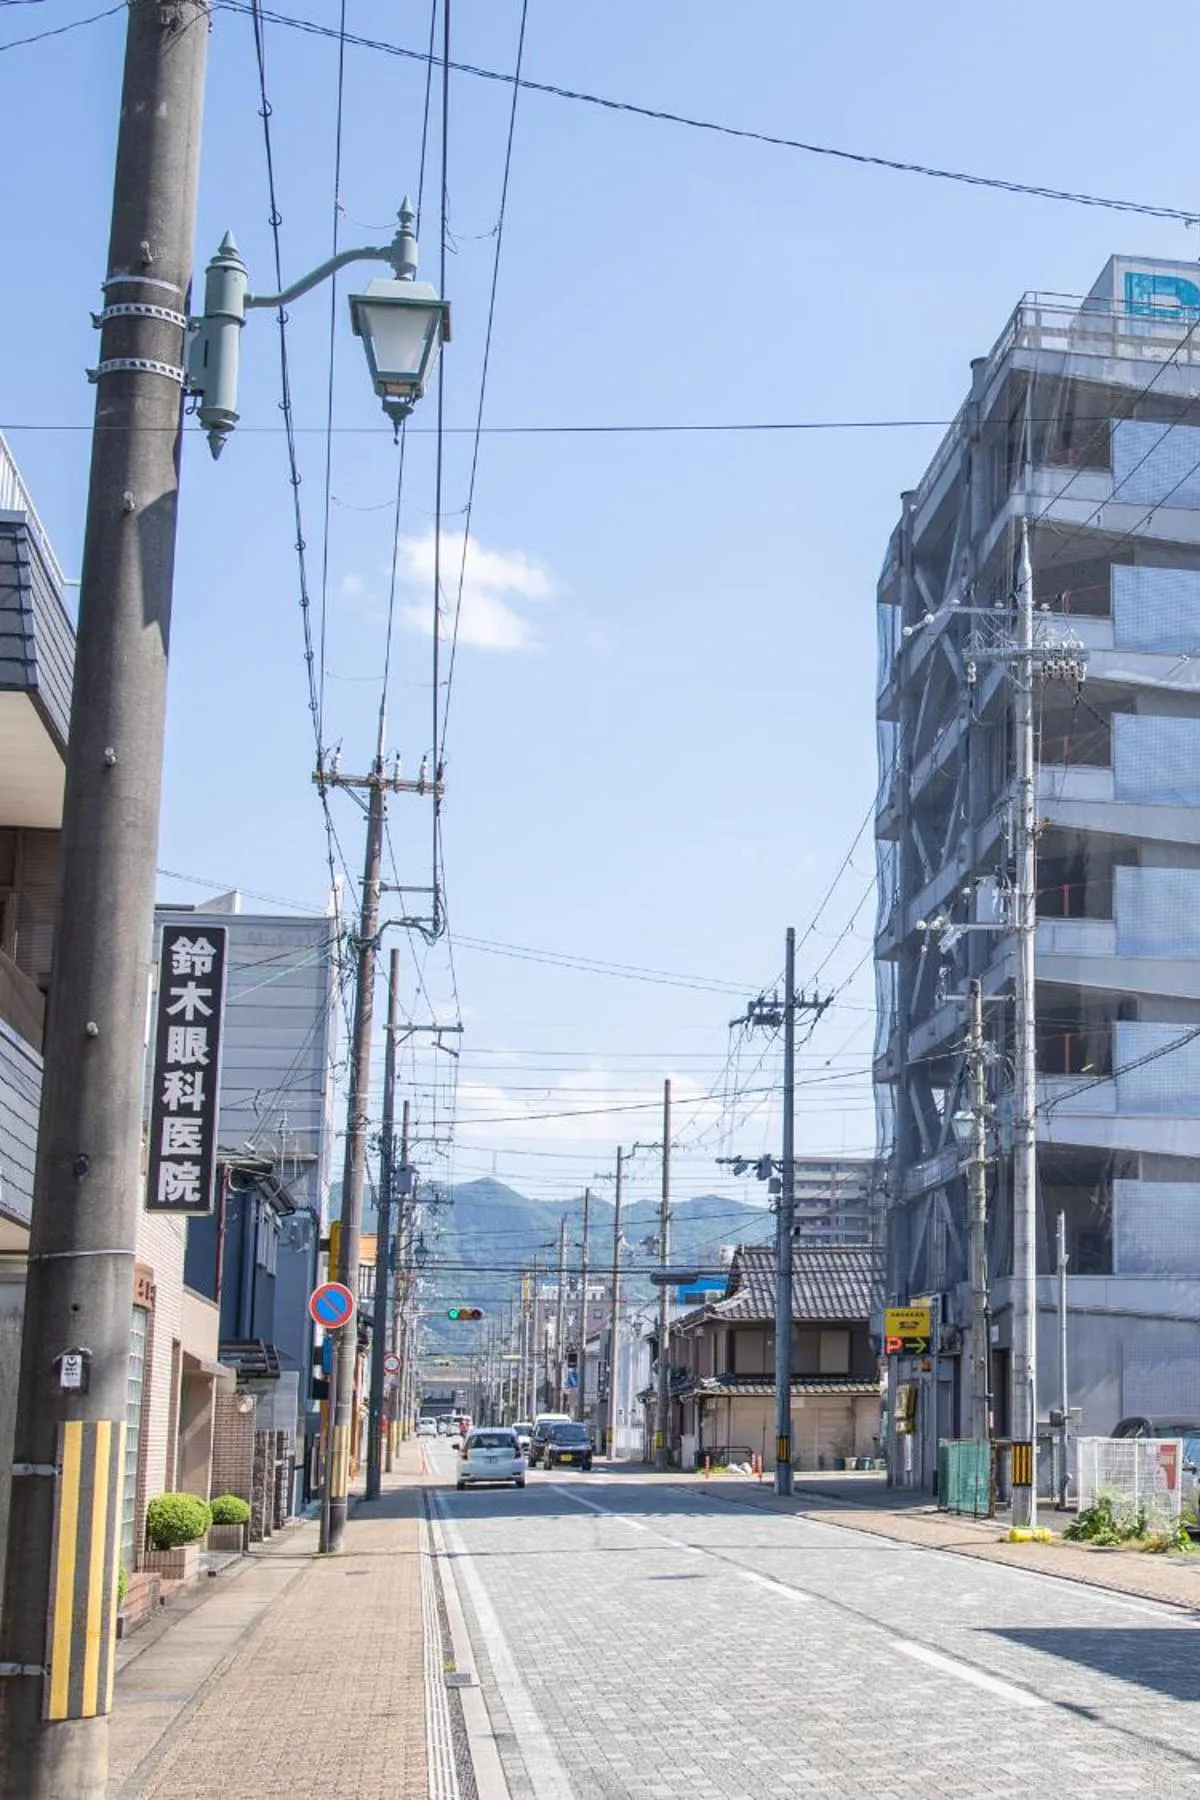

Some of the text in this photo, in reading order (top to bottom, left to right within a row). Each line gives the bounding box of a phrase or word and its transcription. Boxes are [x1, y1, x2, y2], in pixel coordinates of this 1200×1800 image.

[157, 936, 217, 1202] 鈴木眼科医院
[886, 1336, 903, 1355] P
